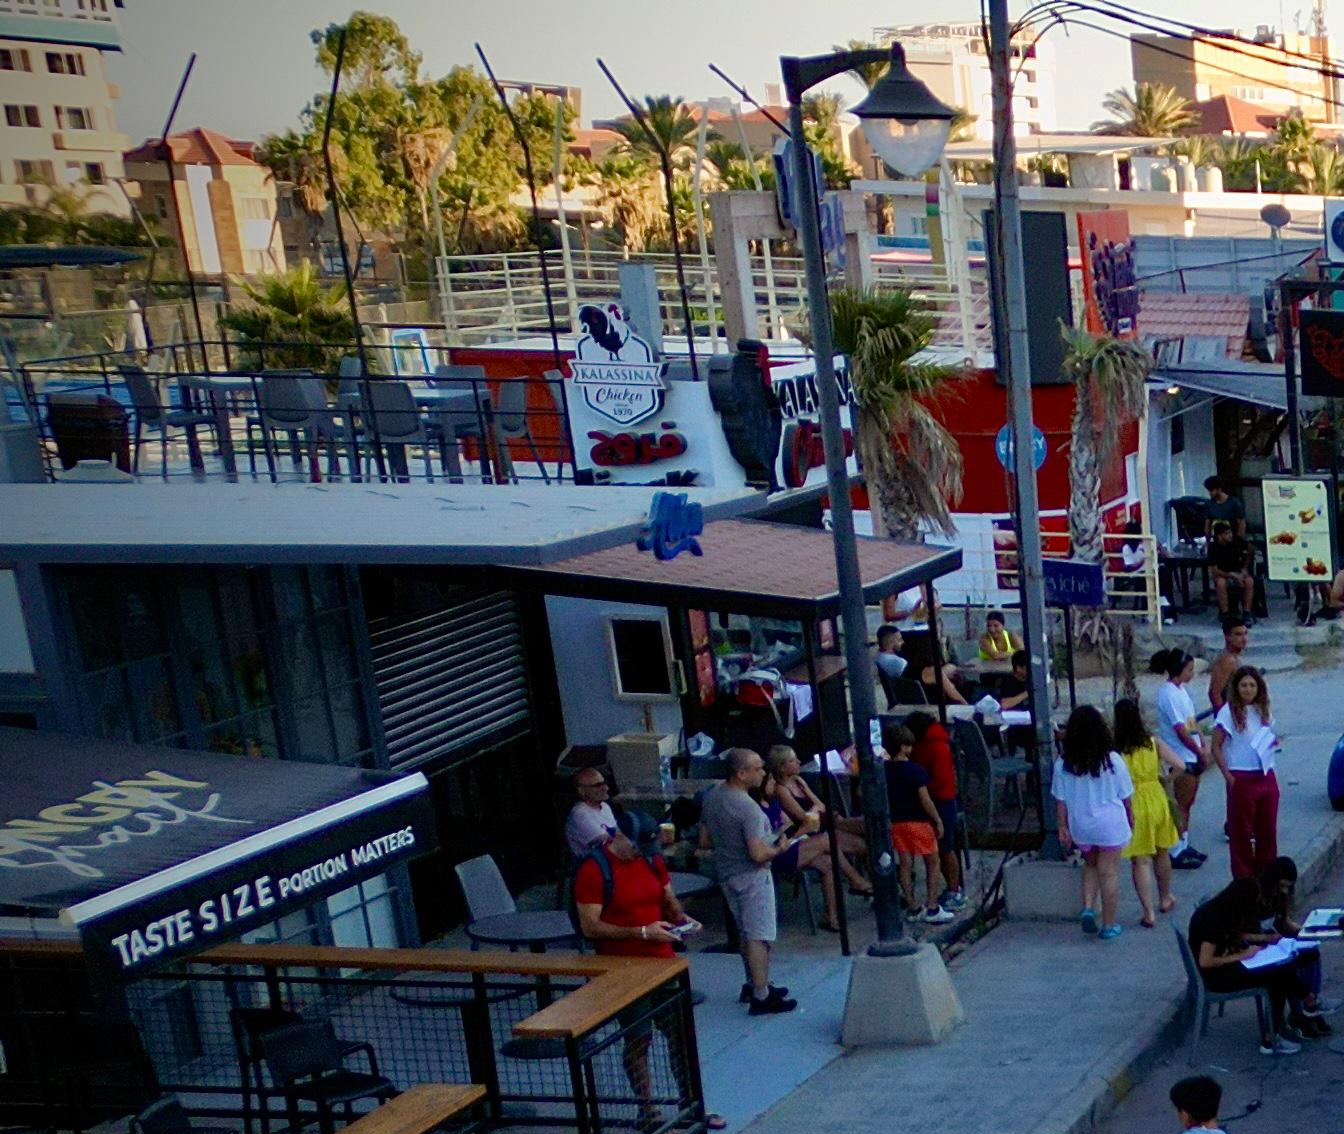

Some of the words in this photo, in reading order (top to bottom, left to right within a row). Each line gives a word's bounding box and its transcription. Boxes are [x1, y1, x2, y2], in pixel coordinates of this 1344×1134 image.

[580, 367, 655, 383] KALASSINA
[595, 387, 644, 405] Chicken
[111, 908, 195, 968] TASTE
[199, 874, 276, 932] SIZE
[278, 853, 348, 898] PORTION
[351, 825, 416, 866] MATTERS
